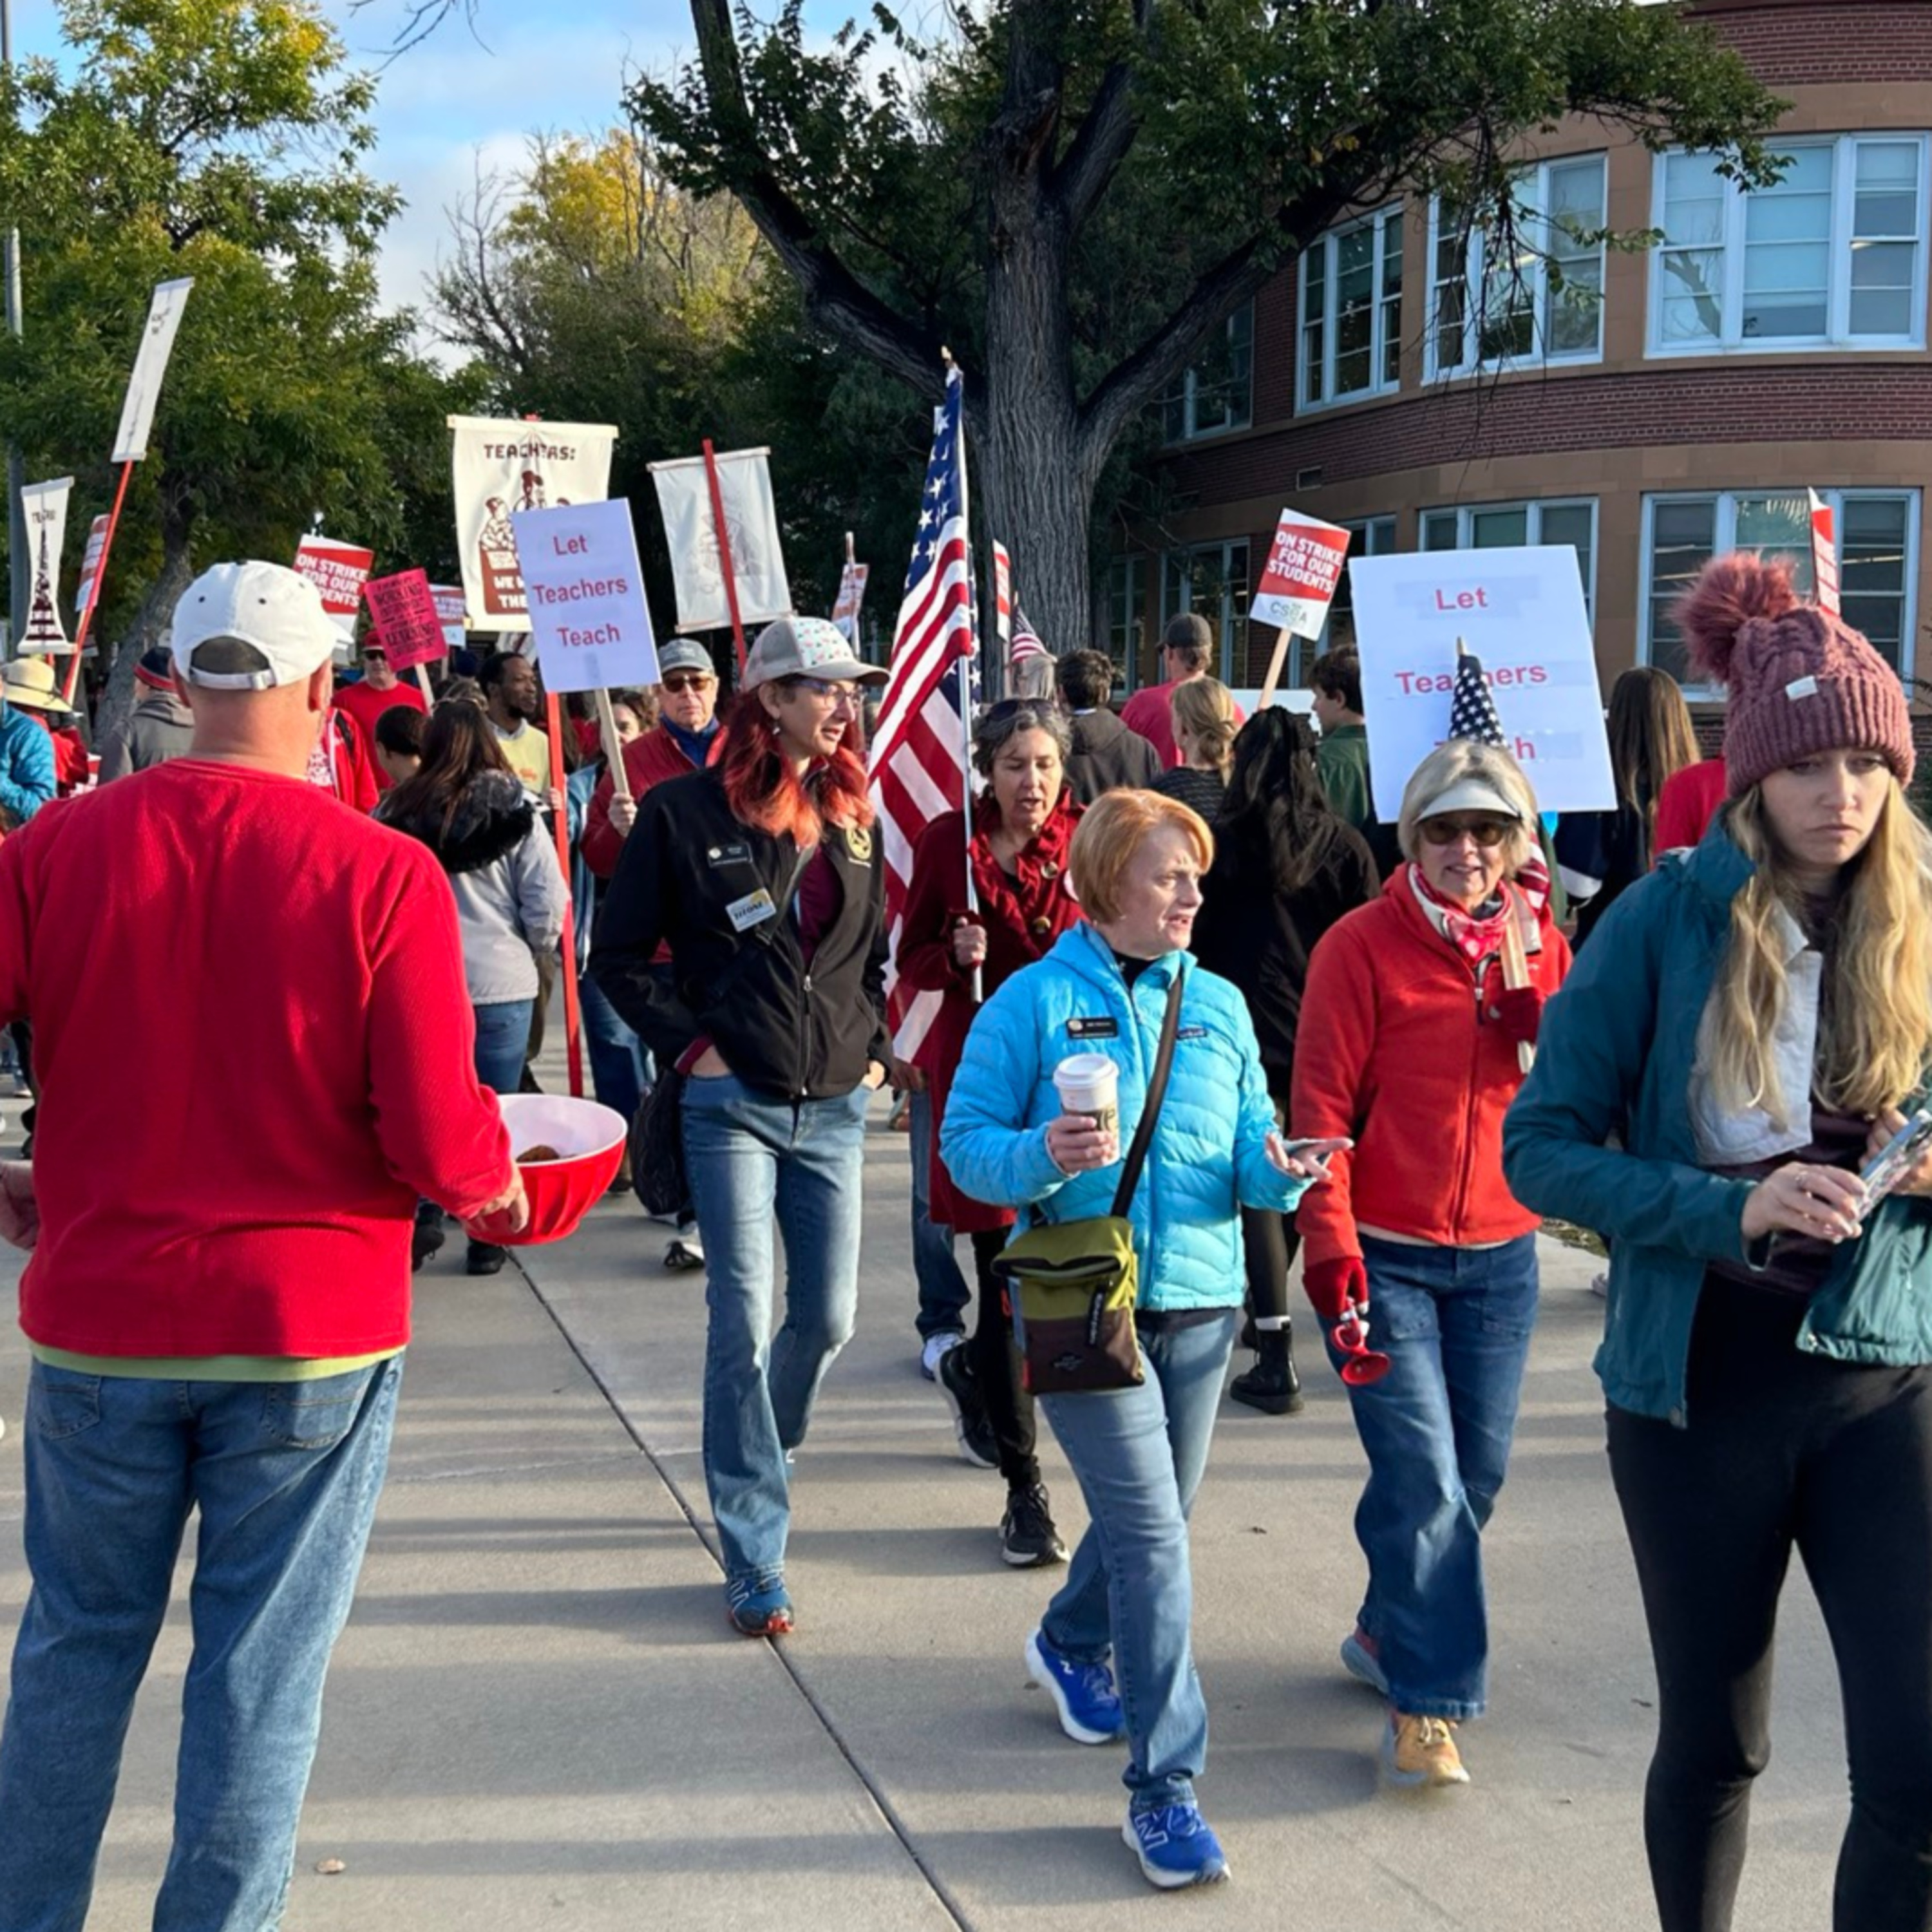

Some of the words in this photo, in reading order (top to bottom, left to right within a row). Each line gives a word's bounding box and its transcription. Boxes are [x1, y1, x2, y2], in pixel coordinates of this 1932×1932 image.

[553, 535, 589, 556] Let
[1276, 531, 1297, 547] ON
[1297, 538, 1344, 565] STRIKE
[296, 554, 318, 569] ON
[319, 558, 369, 583] STRIKE
[1267, 560, 1334, 592] STUDENTS
[1278, 548, 1307, 568] FOR
[1307, 557, 1336, 578] OUR
[302, 569, 329, 587] FOR
[329, 576, 360, 594] OUR
[531, 578, 628, 605] Teachers
[1435, 586, 1489, 611] Let
[557, 623, 621, 647] Teach
[1394, 663, 1548, 696] Teaers
